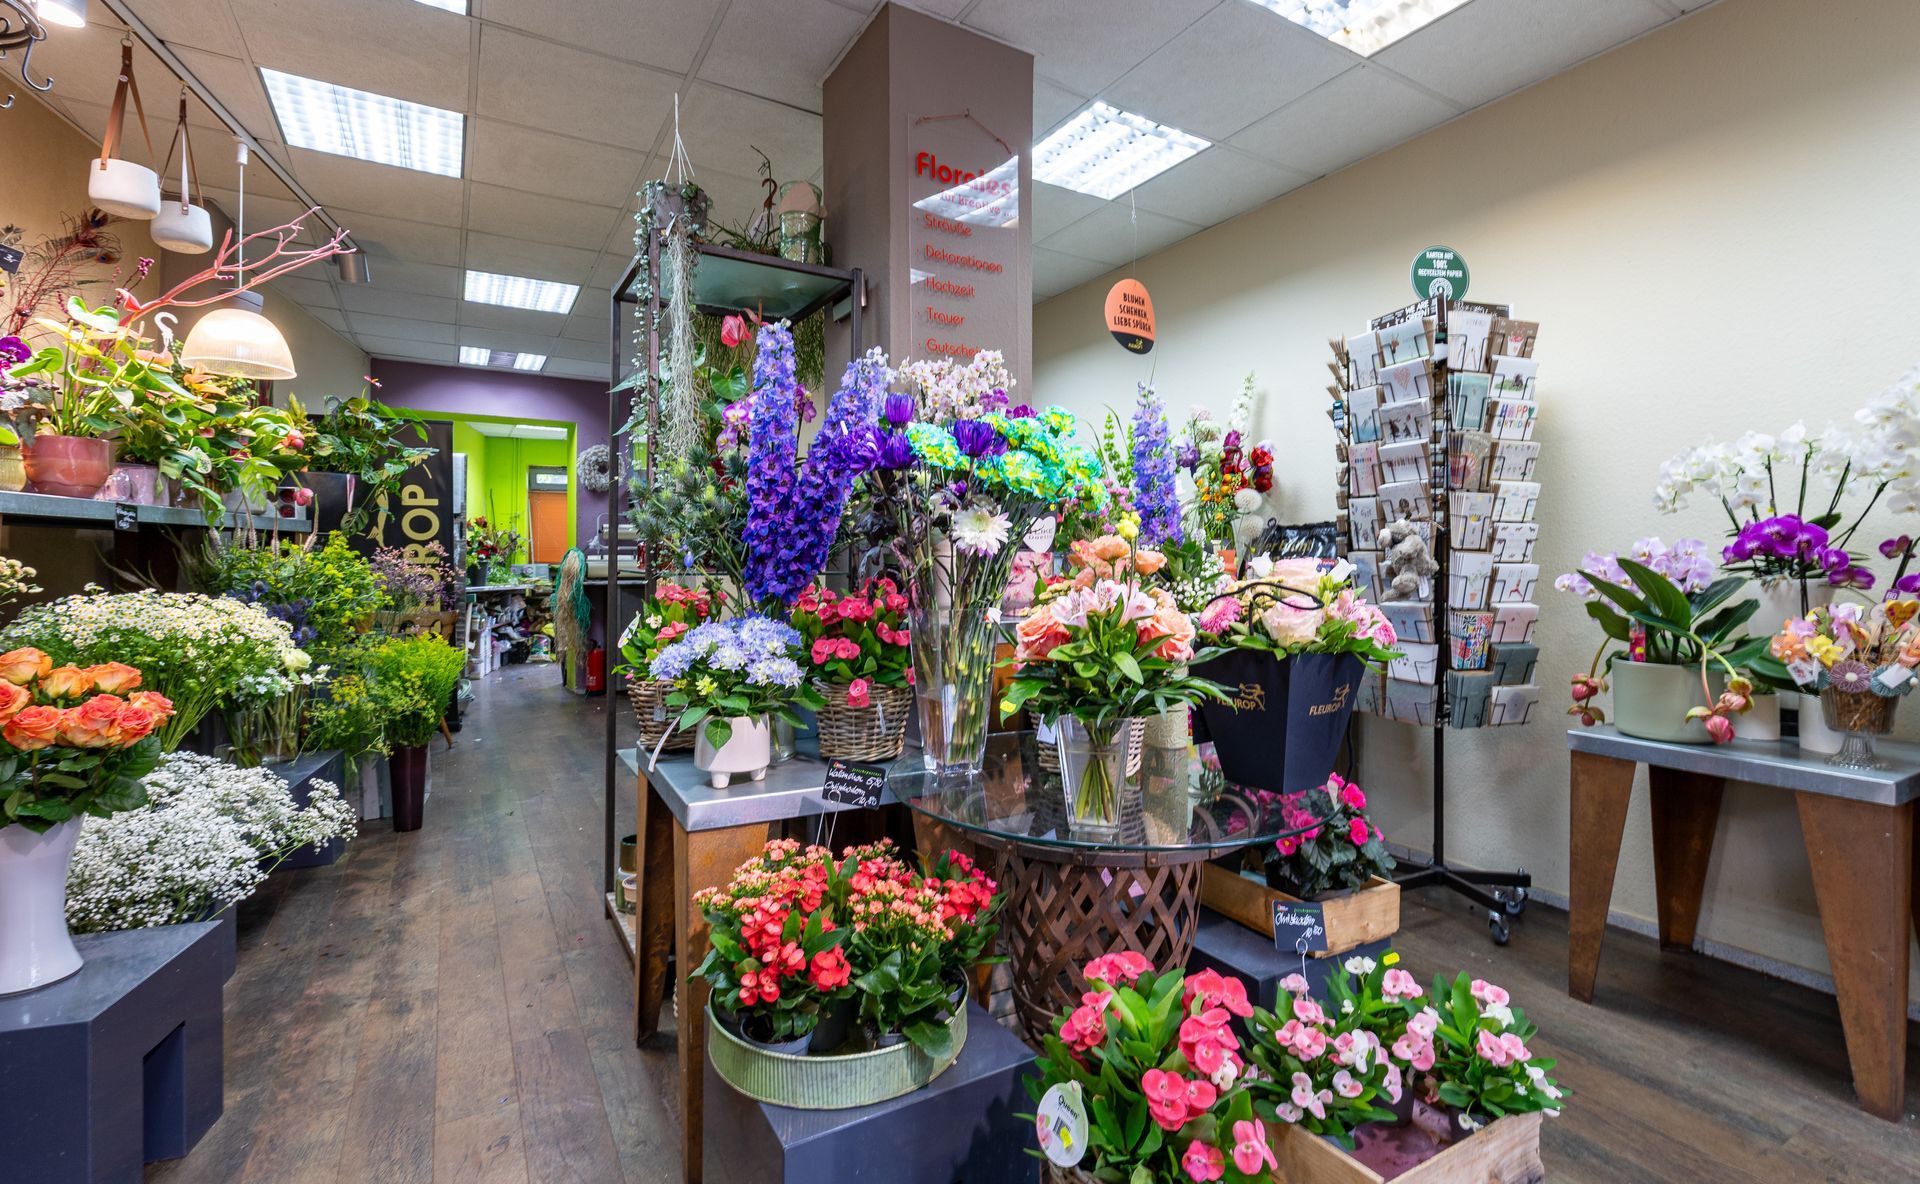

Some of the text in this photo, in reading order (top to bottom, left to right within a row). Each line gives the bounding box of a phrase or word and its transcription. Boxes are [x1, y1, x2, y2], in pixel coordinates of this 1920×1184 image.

[925, 244, 1003, 273] Dekorationen
[926, 275, 976, 297] Hochzeit
[1123, 292, 1145, 306] BLUMEN
[1416, 301, 1430, 310] ARE
[927, 306, 965, 325] Trauer
[1113, 316, 1131, 328] LIEBE
[1309, 701, 1341, 716] FLEUROP
